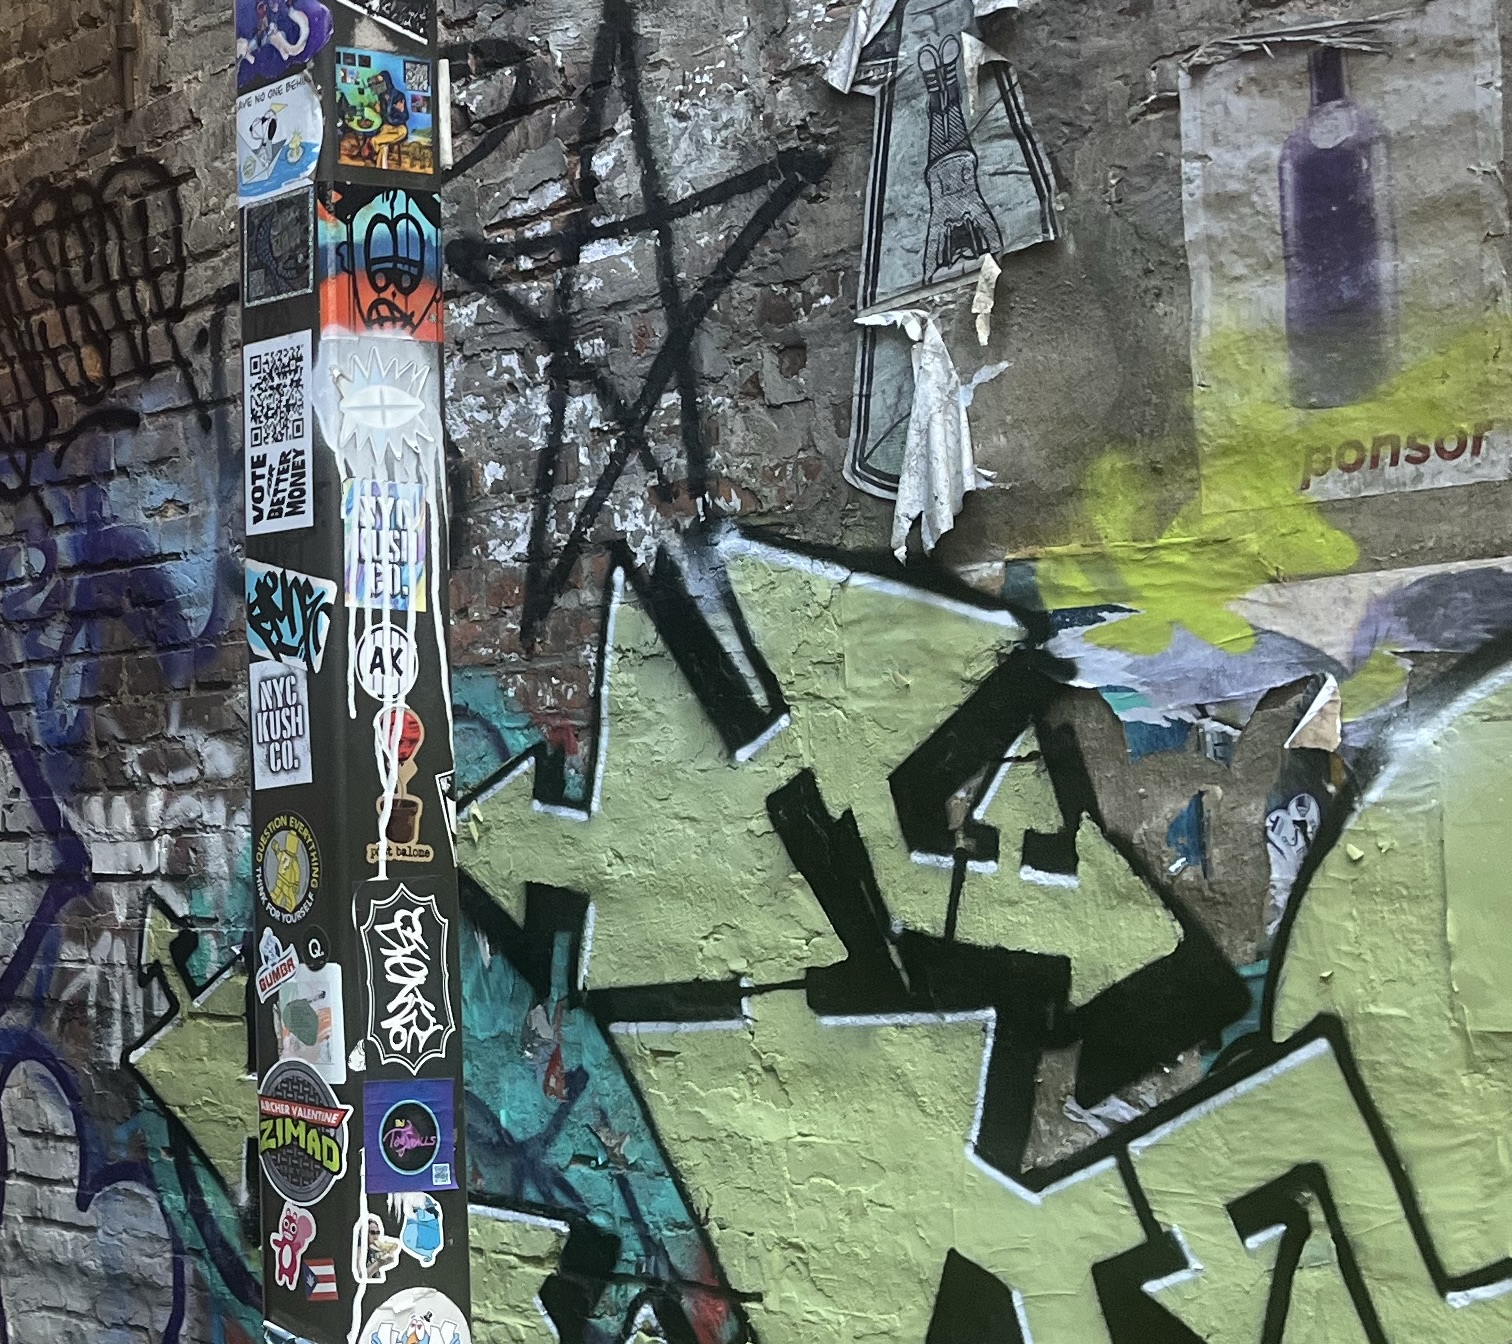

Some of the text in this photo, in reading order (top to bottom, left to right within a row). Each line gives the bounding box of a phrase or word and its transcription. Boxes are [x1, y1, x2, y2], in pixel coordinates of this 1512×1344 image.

[251, 453, 267, 524] VOTE
[267, 449, 292, 521] BETTER
[283, 447, 306, 518] MONEY
[369, 645, 404, 677] AK
[259, 674, 297, 713] NYC
[256, 704, 303, 745] KUSH
[269, 739, 299, 773] CO.
[256, 815, 319, 889] QUESTION EVERYTHING
[255, 866, 316, 925] THINK FOR YOURSELF
[258, 956, 297, 994] GUMBA
[260, 1099, 340, 1124] ARCHER VALENTINE
[260, 1116, 341, 1173] ZIMAD
